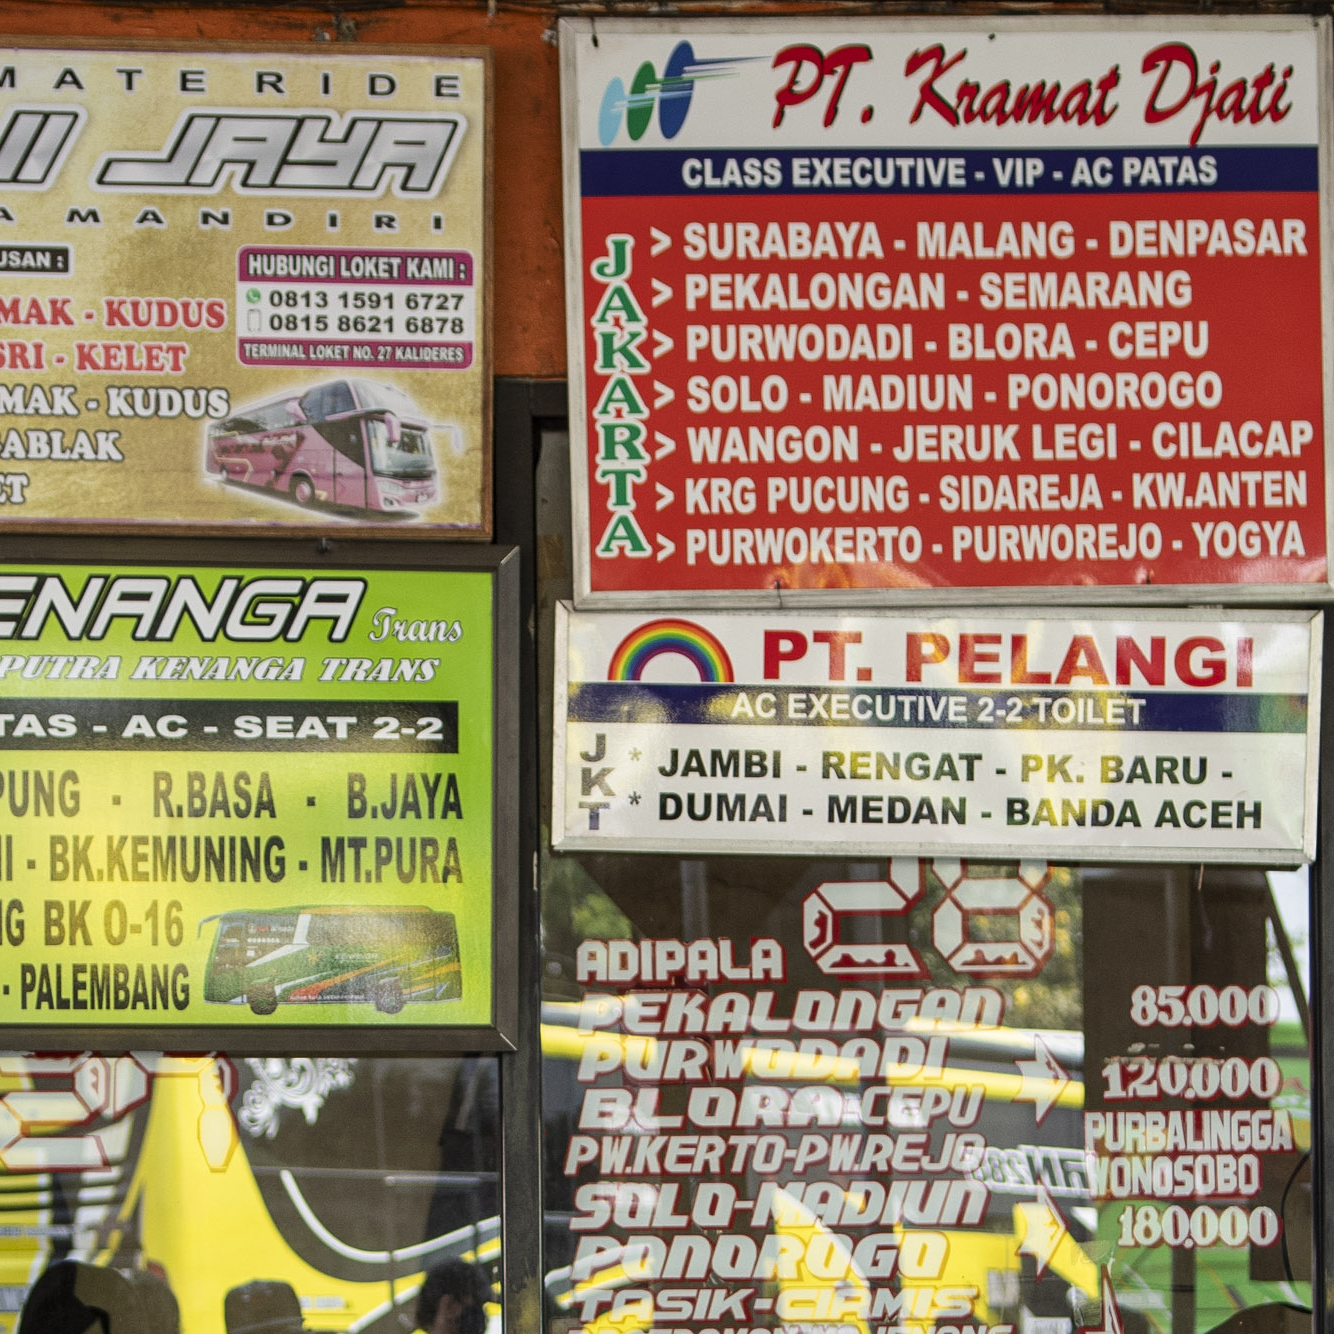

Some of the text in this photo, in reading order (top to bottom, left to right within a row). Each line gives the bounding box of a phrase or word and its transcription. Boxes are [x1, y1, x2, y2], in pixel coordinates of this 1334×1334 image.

[771, 42, 1293, 146] PT. Kramat Djati
[96, 112, 461, 193] JAYA
[682, 157, 1217, 188] CLASS EXECUTIVE VIP AC PATAS
[683, 218, 1307, 259] SURABAYA MALANG DENPASAR
[248, 254, 457, 280] HUBUNGI LOKET KAMI
[104, 298, 226, 330] KUDUS
[270, 289, 465, 310] 0813 1591 6727
[270, 314, 465, 335] 0815 8621 6878
[244, 344, 465, 362] TERMINAL LOKET NO. 27 KALIDERES
[369, 609, 463, 644] Trans
[763, 630, 1254, 688] PT. PELANGI
[730, 693, 1146, 724] AC EXECUTIVE 2-2 TOILET
[122, 714, 187, 738] AC
[234, 716, 356, 739] SEAT
[373, 718, 444, 740] 2-2
[153, 771, 275, 819] R.BASA
[347, 773, 463, 820] B.JAYA
[657, 794, 1262, 829] DUMAI MEDAN BANDA ACEH
[577, 937, 785, 984] ADIPALA
[20, 964, 190, 1011] PALEMBANG
[1130, 985, 1280, 1027] 85.000
[1085, 1110, 1293, 1153] PURBALINGGA
